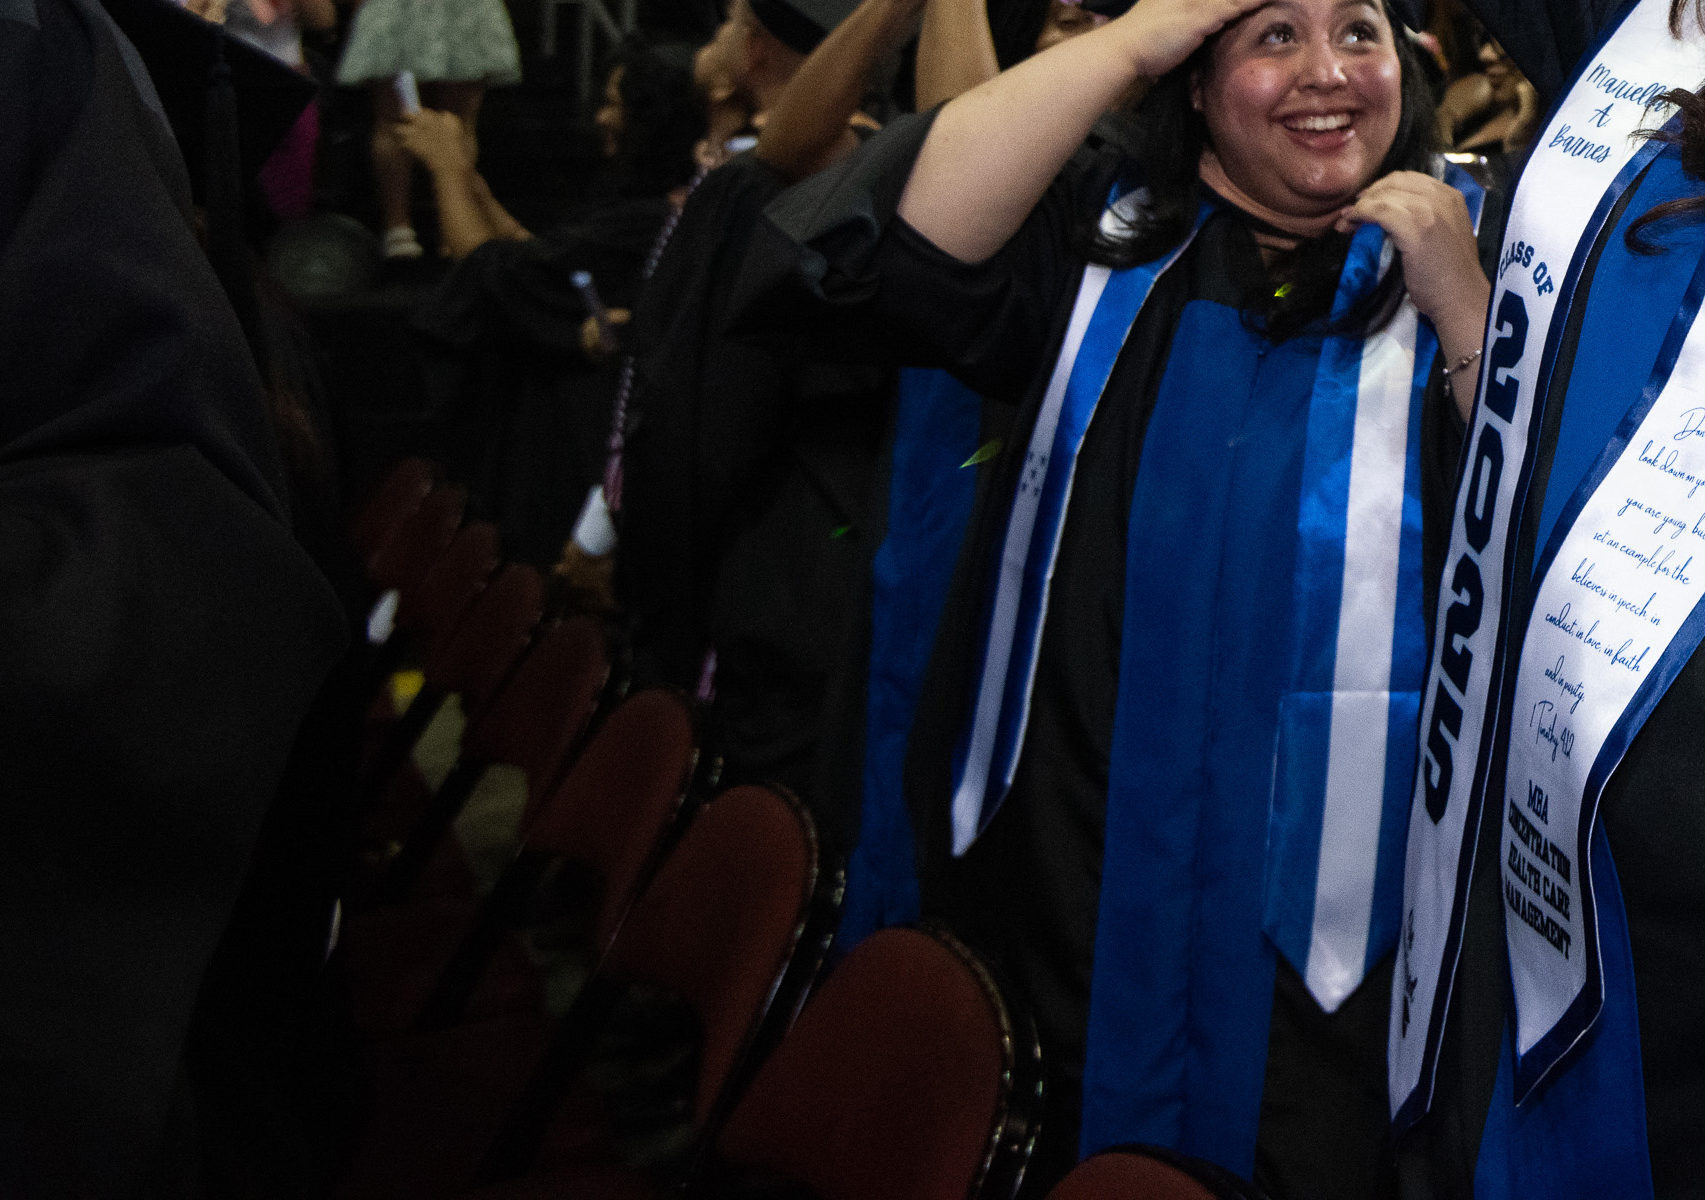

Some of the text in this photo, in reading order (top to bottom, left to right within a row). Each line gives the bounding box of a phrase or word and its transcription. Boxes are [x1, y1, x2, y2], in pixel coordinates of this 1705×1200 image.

[1548, 123, 1612, 164] Barnes
[1499, 241, 1555, 297] CLASS OF
[1638, 439, 1666, 467] look
[1659, 449, 1685, 479] down
[1685, 474, 1696, 484] on
[1617, 497, 1644, 517] you
[1644, 506, 1664, 520] are
[1593, 529, 1693, 586] set an example for the
[1570, 556, 1608, 598] believers
[1608, 589, 1618, 602] in
[1650, 613, 1662, 626] in
[1544, 654, 1565, 683] and
[1575, 626, 1585, 640] in
[1603, 644, 1614, 657] in
[1610, 637, 1651, 673] faith
[1529, 702, 1537, 728] 1
[1527, 779, 1549, 826] MBA
[1505, 874, 1572, 962] MANAGEMENT
[1542, 873, 1572, 923] CARE
